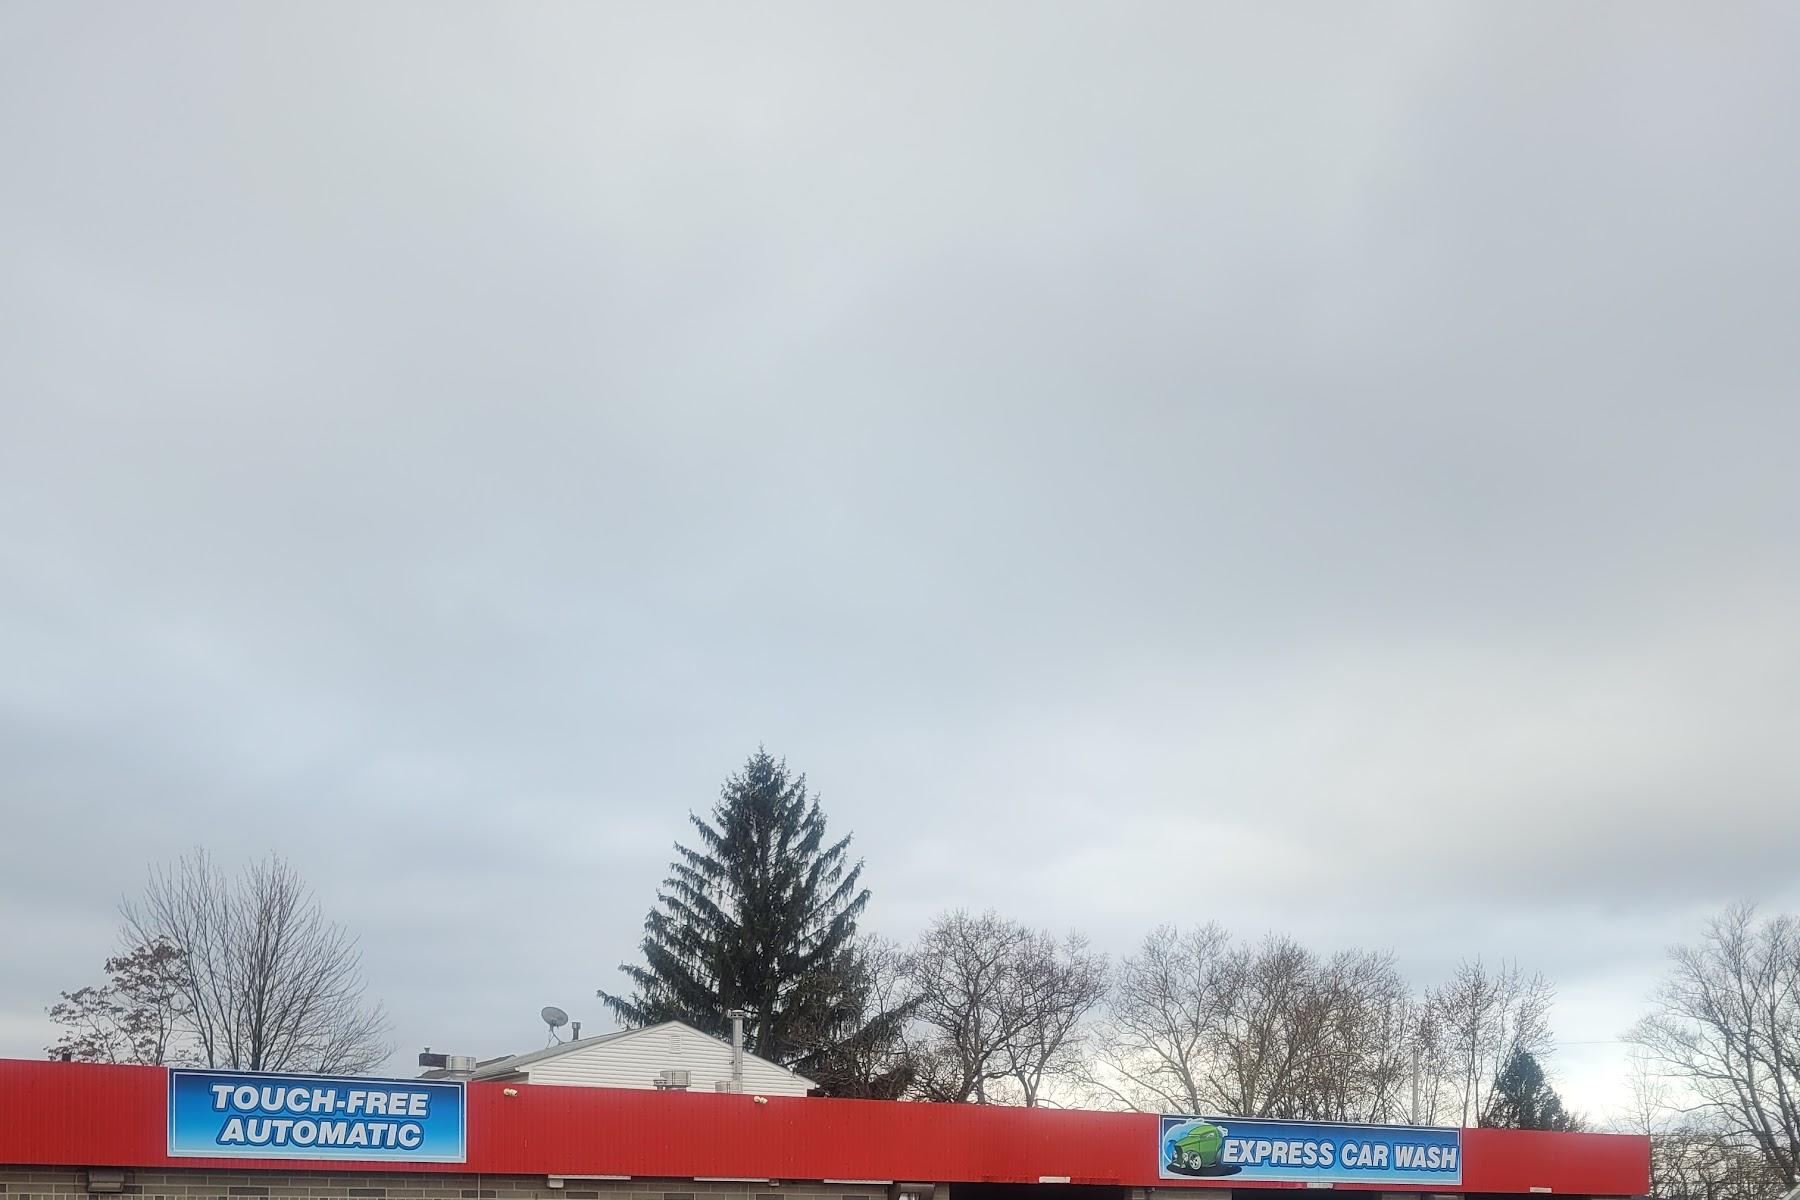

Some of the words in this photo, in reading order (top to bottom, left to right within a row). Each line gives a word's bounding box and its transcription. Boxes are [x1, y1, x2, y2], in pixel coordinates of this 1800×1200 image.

[212, 1085, 430, 1116] TOUCH-FREE
[221, 1119, 424, 1146] AUTOMATIC
[1223, 1139, 1334, 1166] EXPRESS
[1341, 1144, 1388, 1167] CAR
[1395, 1145, 1457, 1169] WASH
